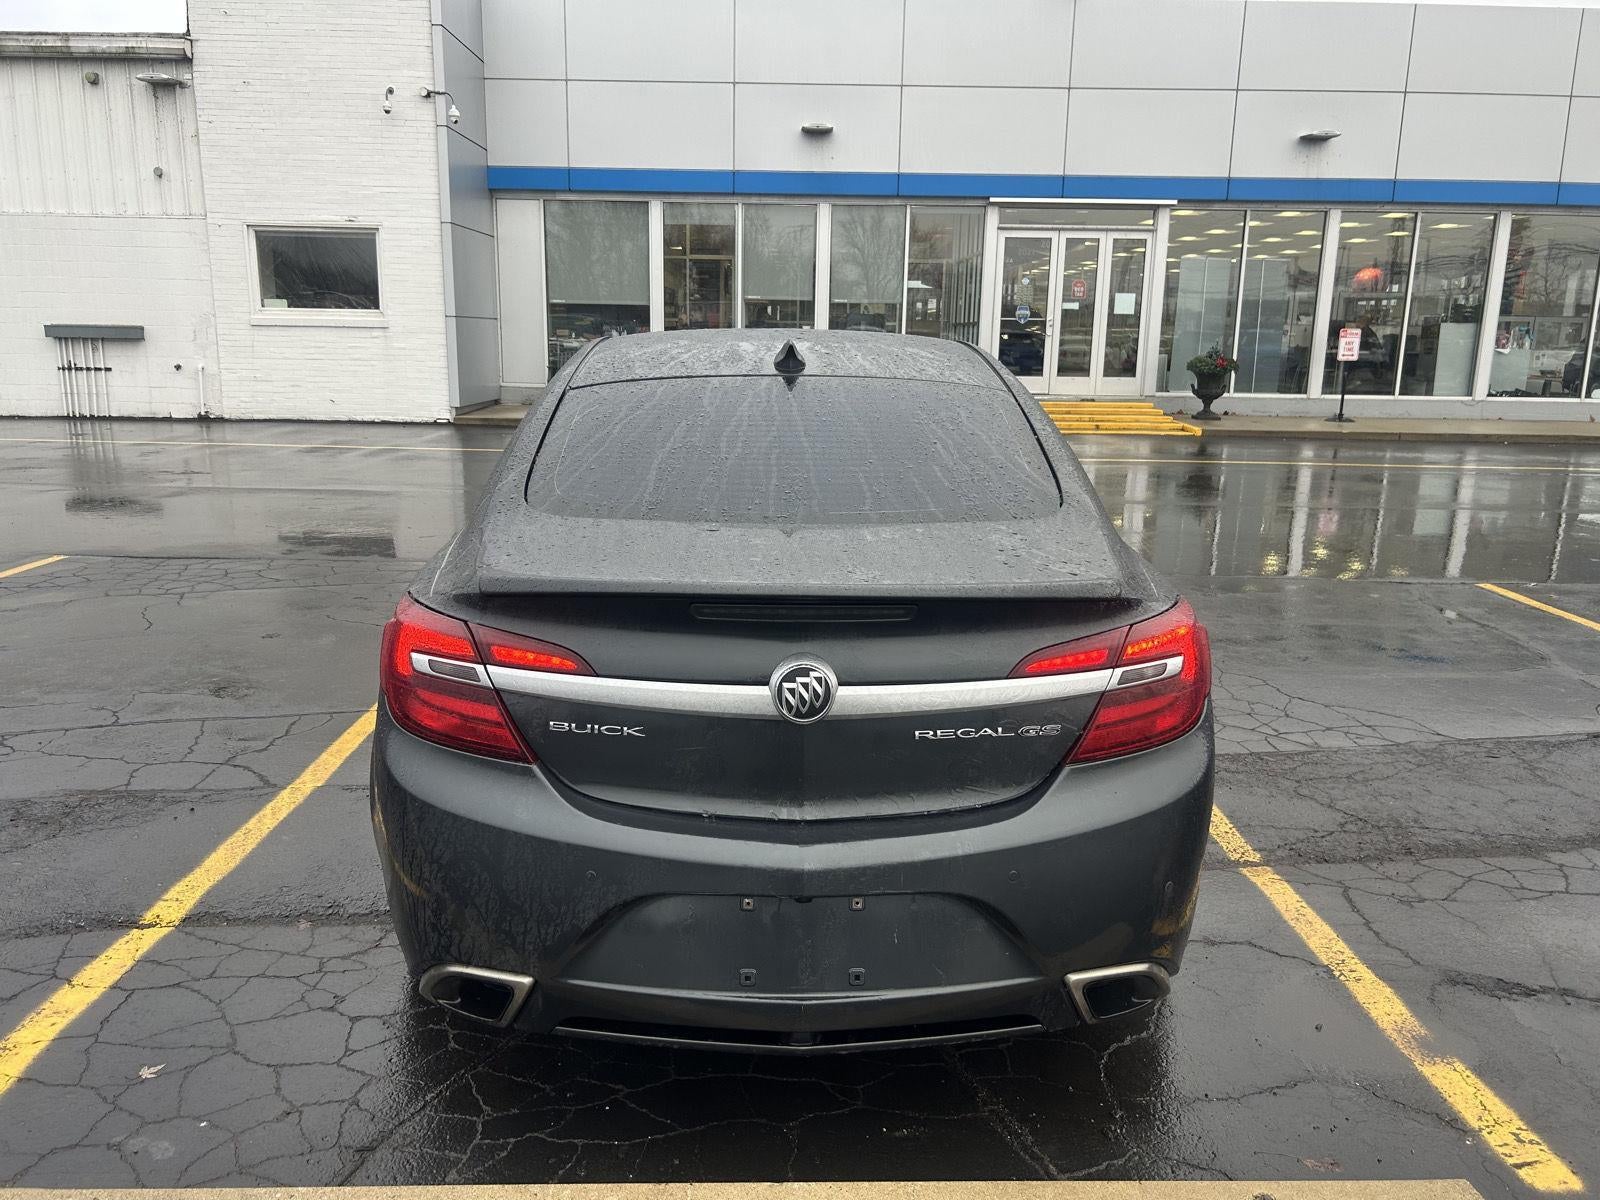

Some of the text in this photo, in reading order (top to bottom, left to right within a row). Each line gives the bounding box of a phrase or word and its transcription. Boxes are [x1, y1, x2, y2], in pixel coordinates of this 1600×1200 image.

[549, 721, 646, 737] BUICK
[914, 724, 1062, 740] REGAL GS
